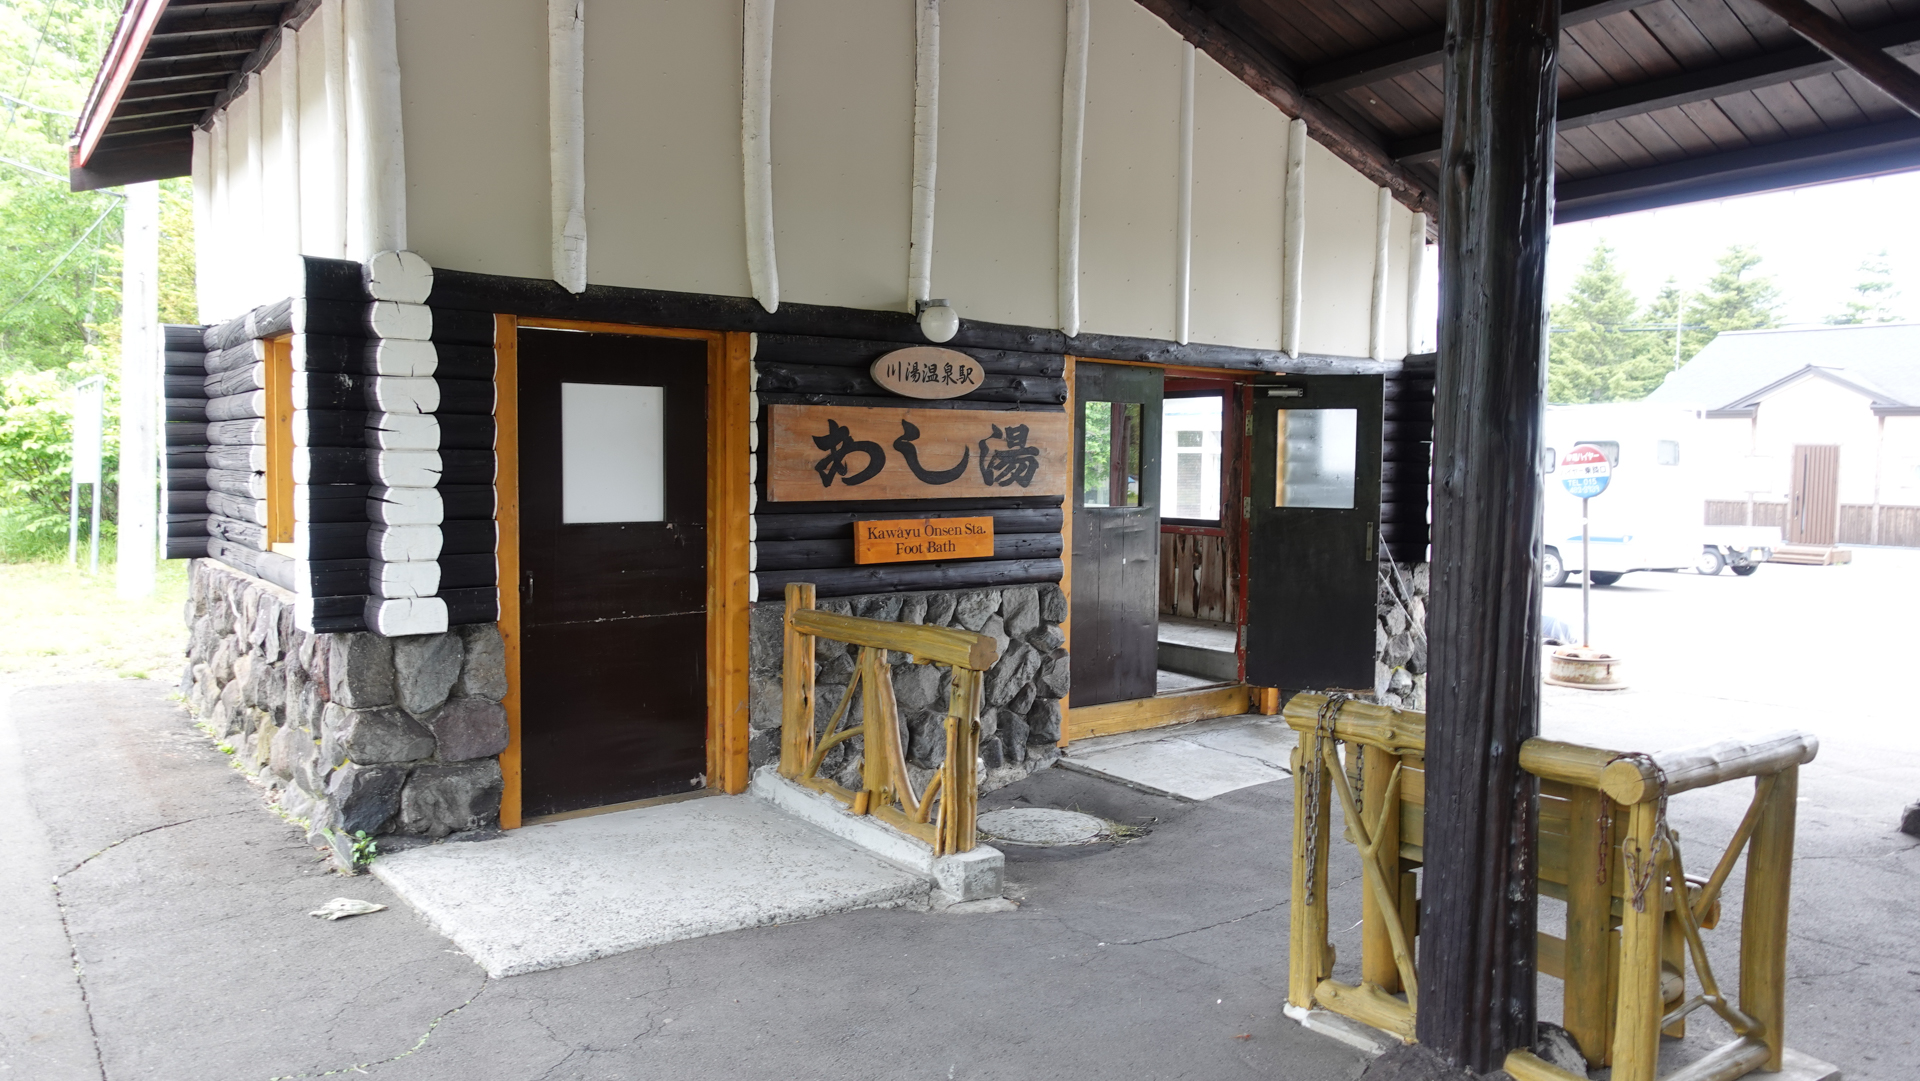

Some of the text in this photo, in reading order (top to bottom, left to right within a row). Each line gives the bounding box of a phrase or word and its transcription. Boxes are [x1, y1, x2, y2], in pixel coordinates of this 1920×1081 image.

[886, 361, 975, 386] 川湯温泉駅
[811, 418, 1040, 488] あし湯
[867, 523, 987, 540] Kawayu Onsen Sta.
[895, 540, 957, 556] Foot Bath
